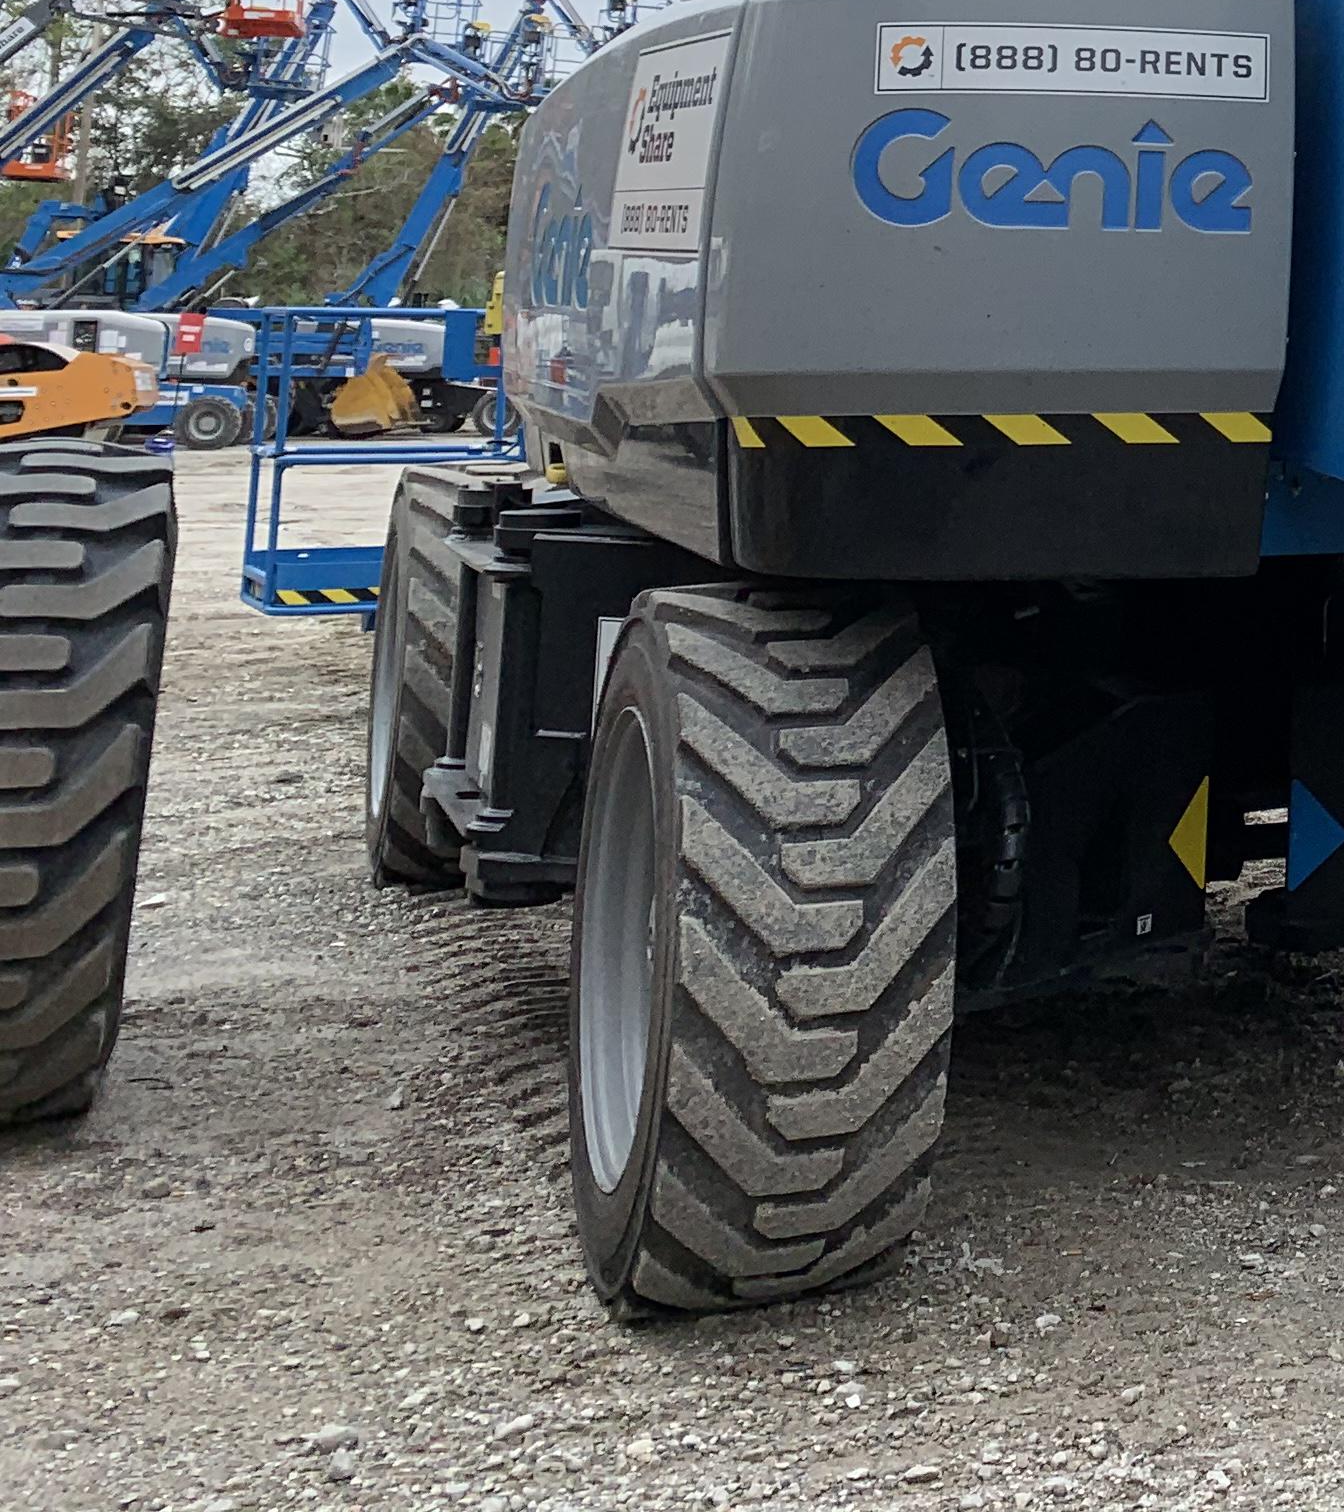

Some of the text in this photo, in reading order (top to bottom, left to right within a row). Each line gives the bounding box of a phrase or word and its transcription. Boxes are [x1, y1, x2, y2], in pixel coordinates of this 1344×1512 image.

[955, 41, 1253, 79] (888) 80-RENTS
[647, 66, 717, 122] Equipment
[639, 123, 675, 164] Share
[850, 108, 1254, 234] Genie
